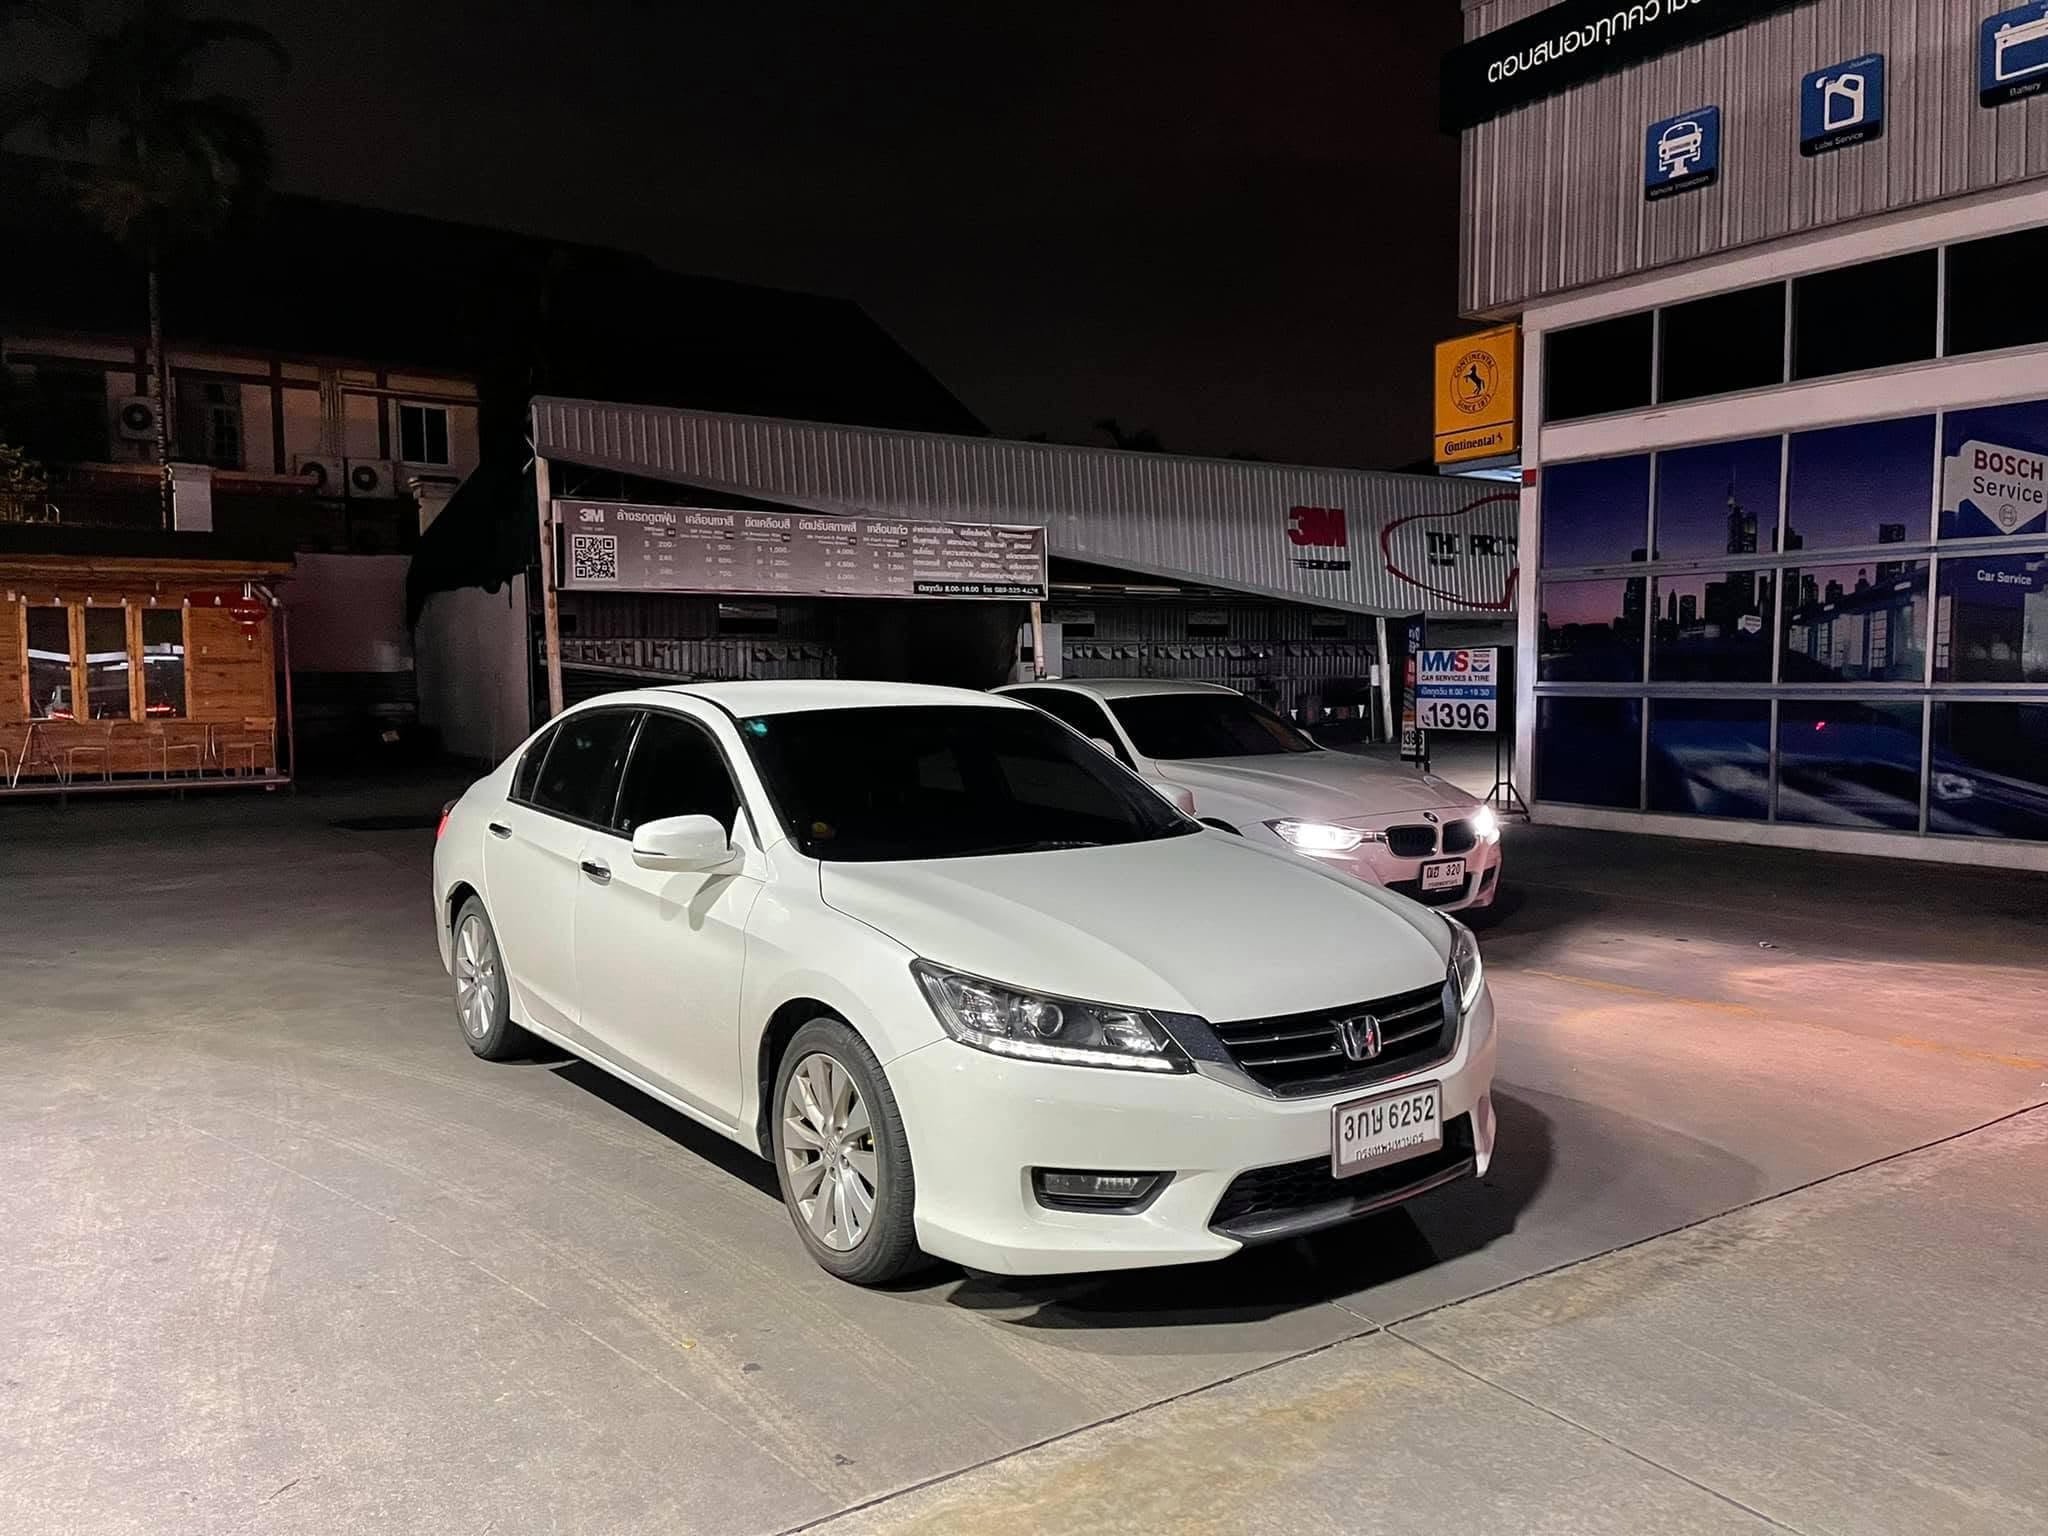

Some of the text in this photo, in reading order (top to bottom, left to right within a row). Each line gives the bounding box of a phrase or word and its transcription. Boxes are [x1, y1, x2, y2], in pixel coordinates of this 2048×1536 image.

[1835, 132, 1864, 145] Service
[1444, 433, 1495, 456] Continental
[1974, 449, 2044, 481] BOSCH
[1973, 475, 2043, 504] Service
[580, 508, 605, 523] 3M
[1288, 505, 1347, 548] 3M
[1976, 569, 2032, 586] Car Service
[1422, 650, 1469, 672] MMS
[1422, 674, 1434, 682] CAR
[1435, 674, 1466, 682] SERVICES
[1474, 674, 1489, 682] TIRE
[1428, 702, 1490, 730] 1396
[1446, 863, 1461, 876] 320
[1344, 1094, 1435, 1142] 3กษ 6252
